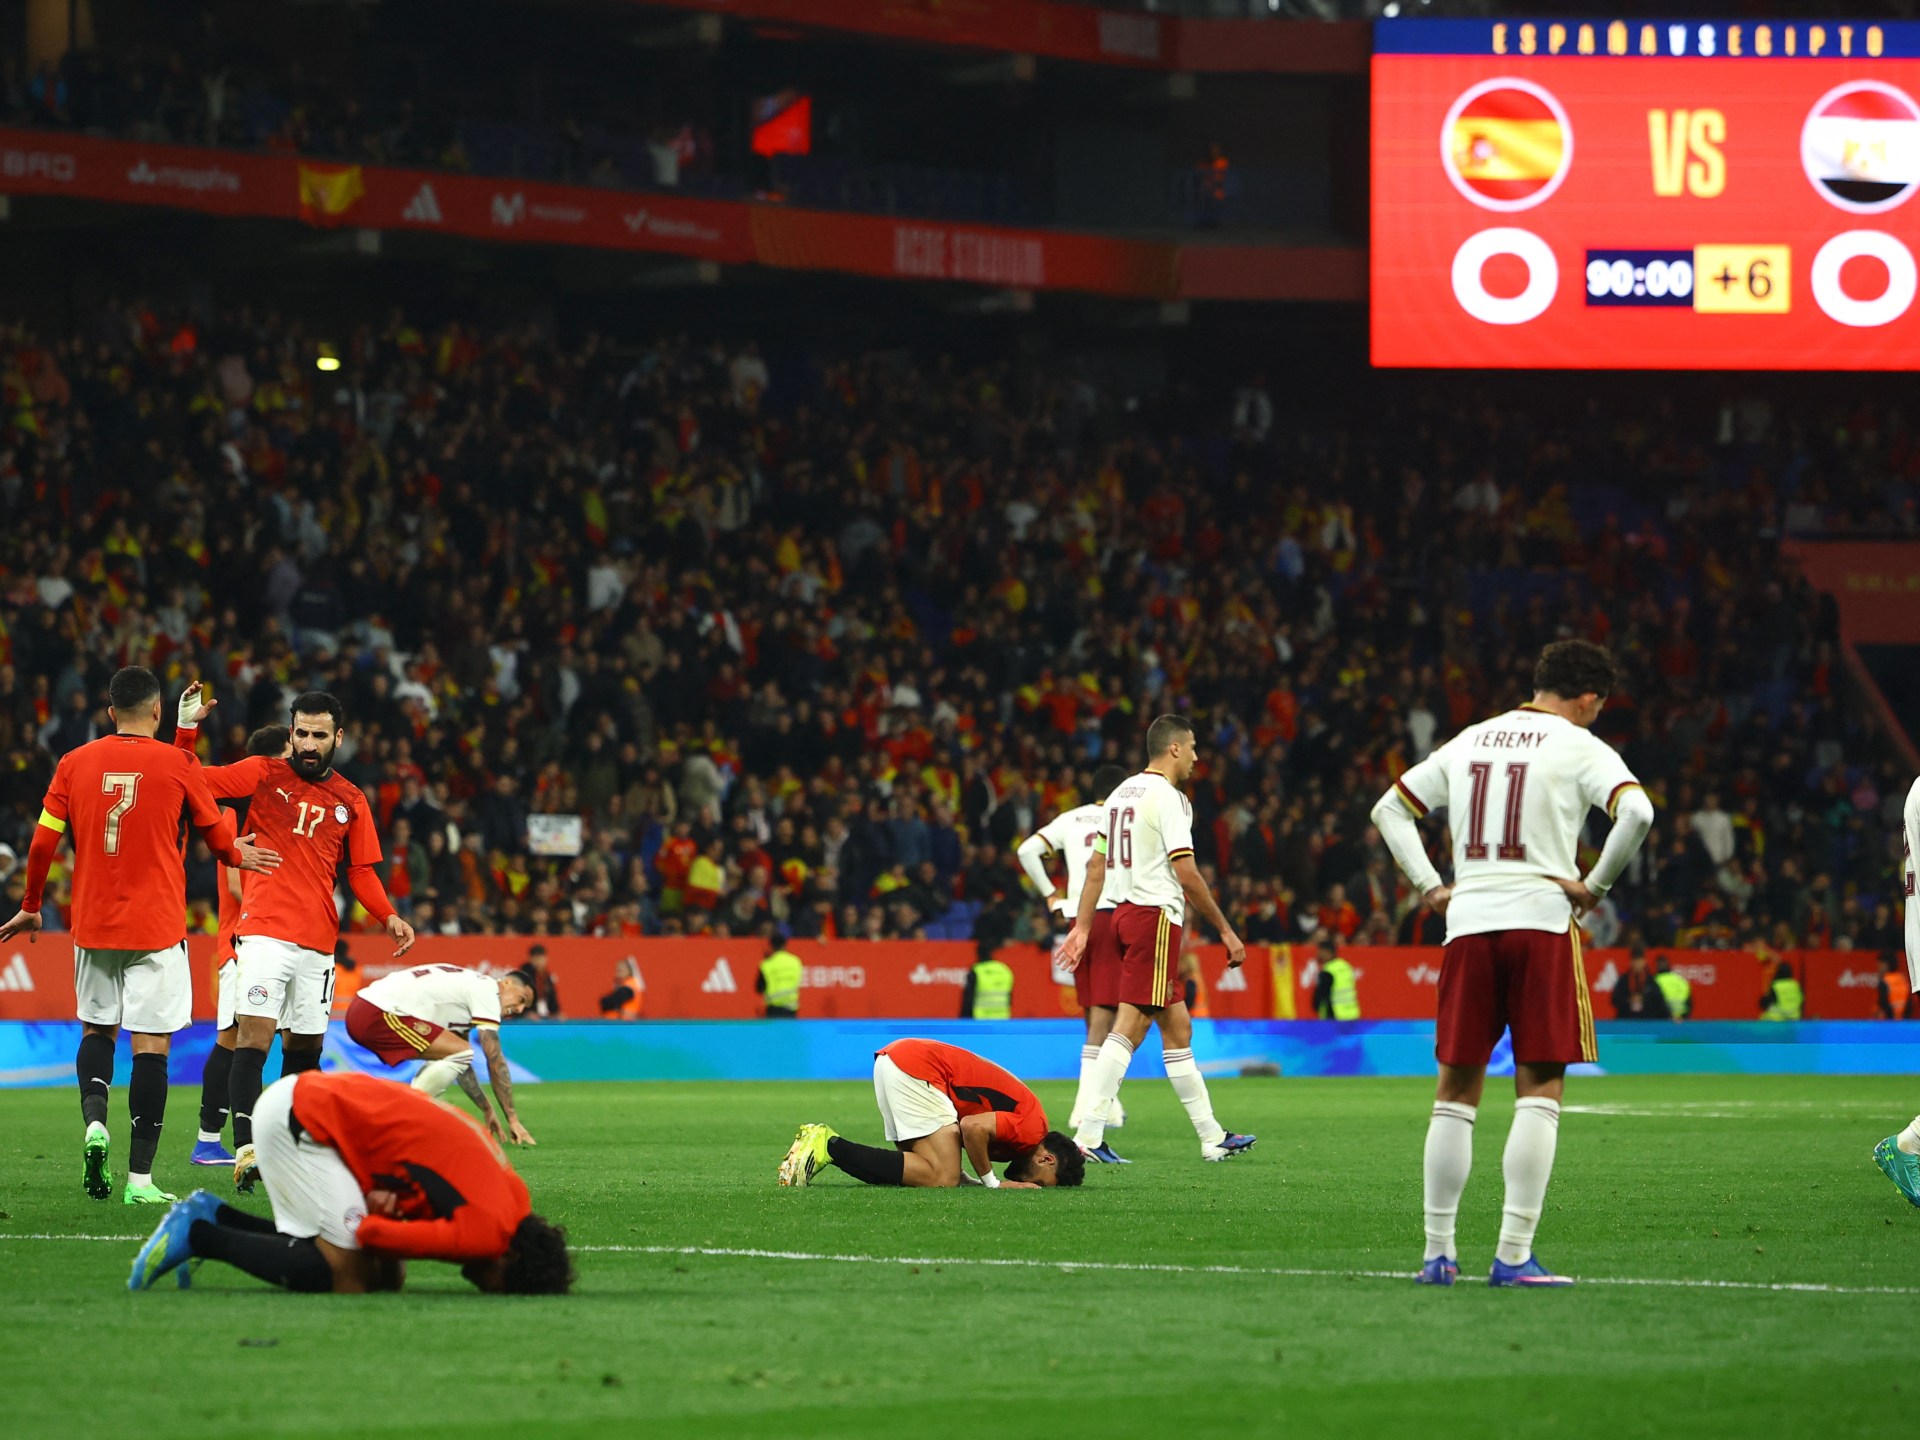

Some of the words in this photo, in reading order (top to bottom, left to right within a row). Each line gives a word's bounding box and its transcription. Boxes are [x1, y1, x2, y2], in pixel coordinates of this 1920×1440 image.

[1491, 19, 1658, 56] ESPAÑA
[1668, 23, 1716, 57] VS
[1727, 24, 1884, 57] EGIPTO
[1647, 108, 1727, 198] VS
[1451, 226, 1559, 325] 0
[1586, 258, 1694, 298] 90:00
[1712, 257, 1773, 299] +6
[1811, 229, 1918, 327] 0
[102, 772, 144, 856] 7
[292, 801, 327, 838] 17
[1106, 806, 1136, 869] 16
[1465, 761, 1530, 862] 11
